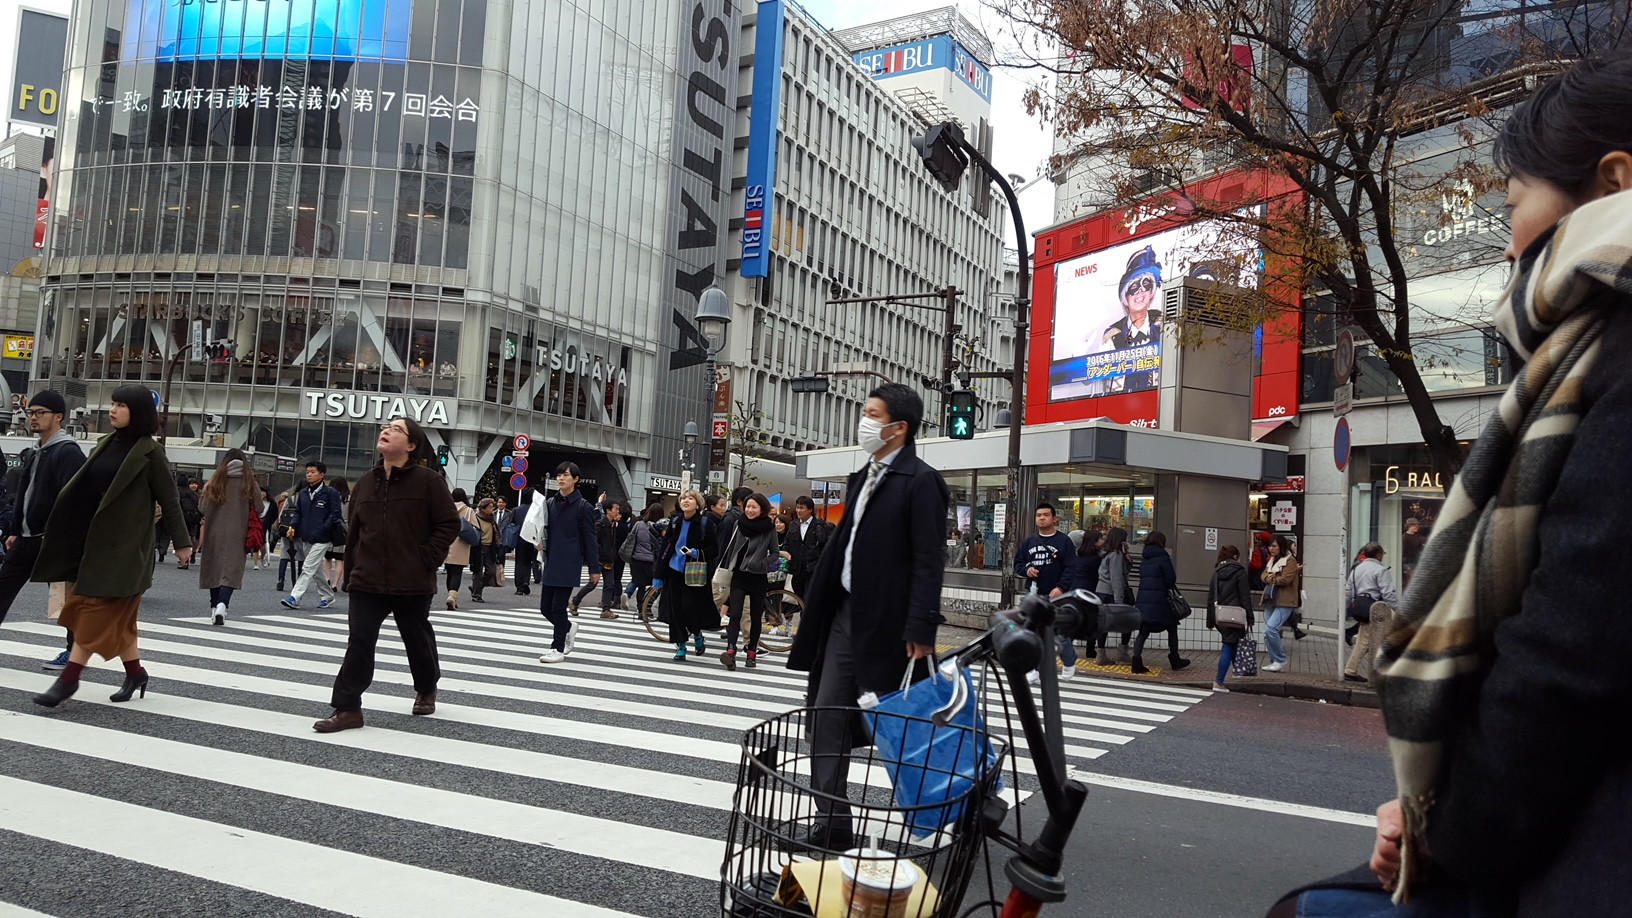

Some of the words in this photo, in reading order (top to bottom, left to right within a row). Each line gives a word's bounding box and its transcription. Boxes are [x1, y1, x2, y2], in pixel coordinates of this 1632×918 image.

[859, 43, 933, 75] SEIBU
[954, 49, 988, 98] SEIBU
[743, 184, 763, 259] SEIBU
[1423, 213, 1503, 246] COFFEE
[1074, 263, 1098, 278] NEWS
[537, 345, 628, 387] TSUTAYA
[306, 391, 449, 425] TSUTAYA
[1268, 406, 1286, 417] pdc
[651, 477, 681, 490] TSUTAYA
